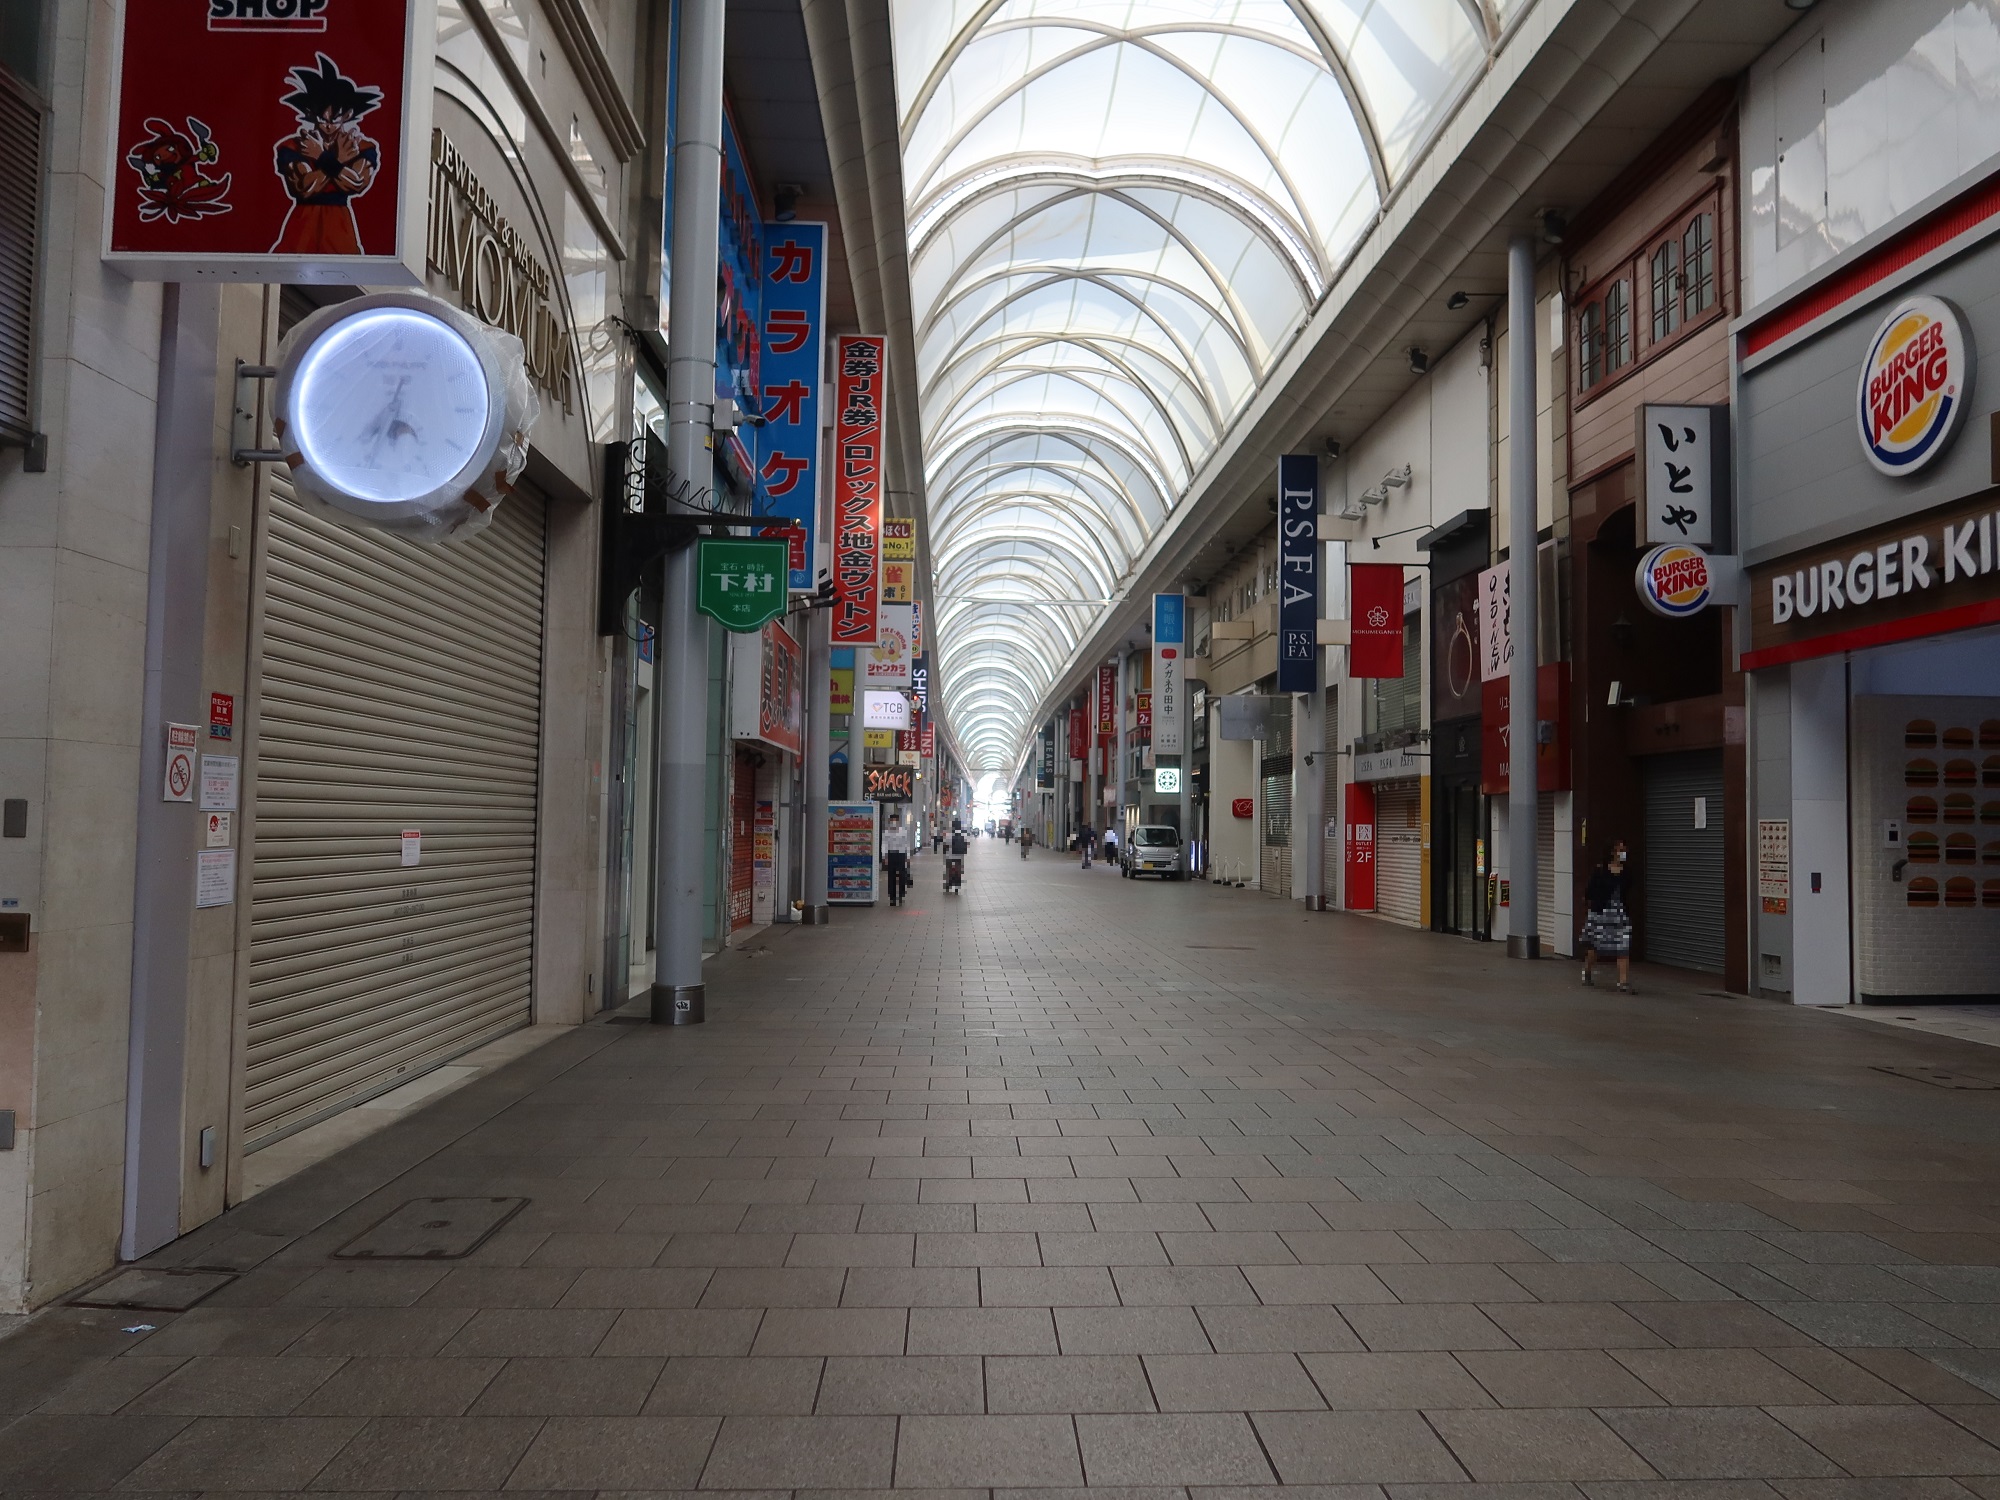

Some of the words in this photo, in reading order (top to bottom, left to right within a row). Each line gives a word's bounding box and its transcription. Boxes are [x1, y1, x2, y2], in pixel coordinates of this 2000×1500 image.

[210, 0, 327, 18] SHOP
[435, 128, 500, 233] JEWELRY
[501, 217, 511, 248] &
[513, 229, 551, 300] WATCH
[1869, 321, 1944, 409] BURGER
[1873, 346, 1949, 448] KING
[1657, 423, 1698, 536] いとや
[1283, 487, 1314, 608] P.S.FA
[710, 573, 775, 593] 下村
[720, 563, 765, 572] 宝石・時計
[1653, 556, 1705, 583] BURGER
[1772, 534, 1931, 625] BURGER
[1943, 510, 2000, 584] KI
[1489, 575, 1498, 619] OLD
[1656, 568, 1708, 601] KING
[732, 604, 751, 612] 本店
[1288, 633, 1311, 645] P.S.
[1490, 628, 1500, 673] NEW
[867, 664, 906, 672] ジャンカラ
[1101, 668, 1111, 721] サンドラッグ
[1163, 660, 1174, 715] メガネの田中
[883, 702, 903, 714] TCB
[1139, 714, 1149, 724] 2F
[1045, 740, 1053, 773] BEAMS
[868, 769, 912, 798] SHACK
[1356, 851, 1372, 863] 2F
